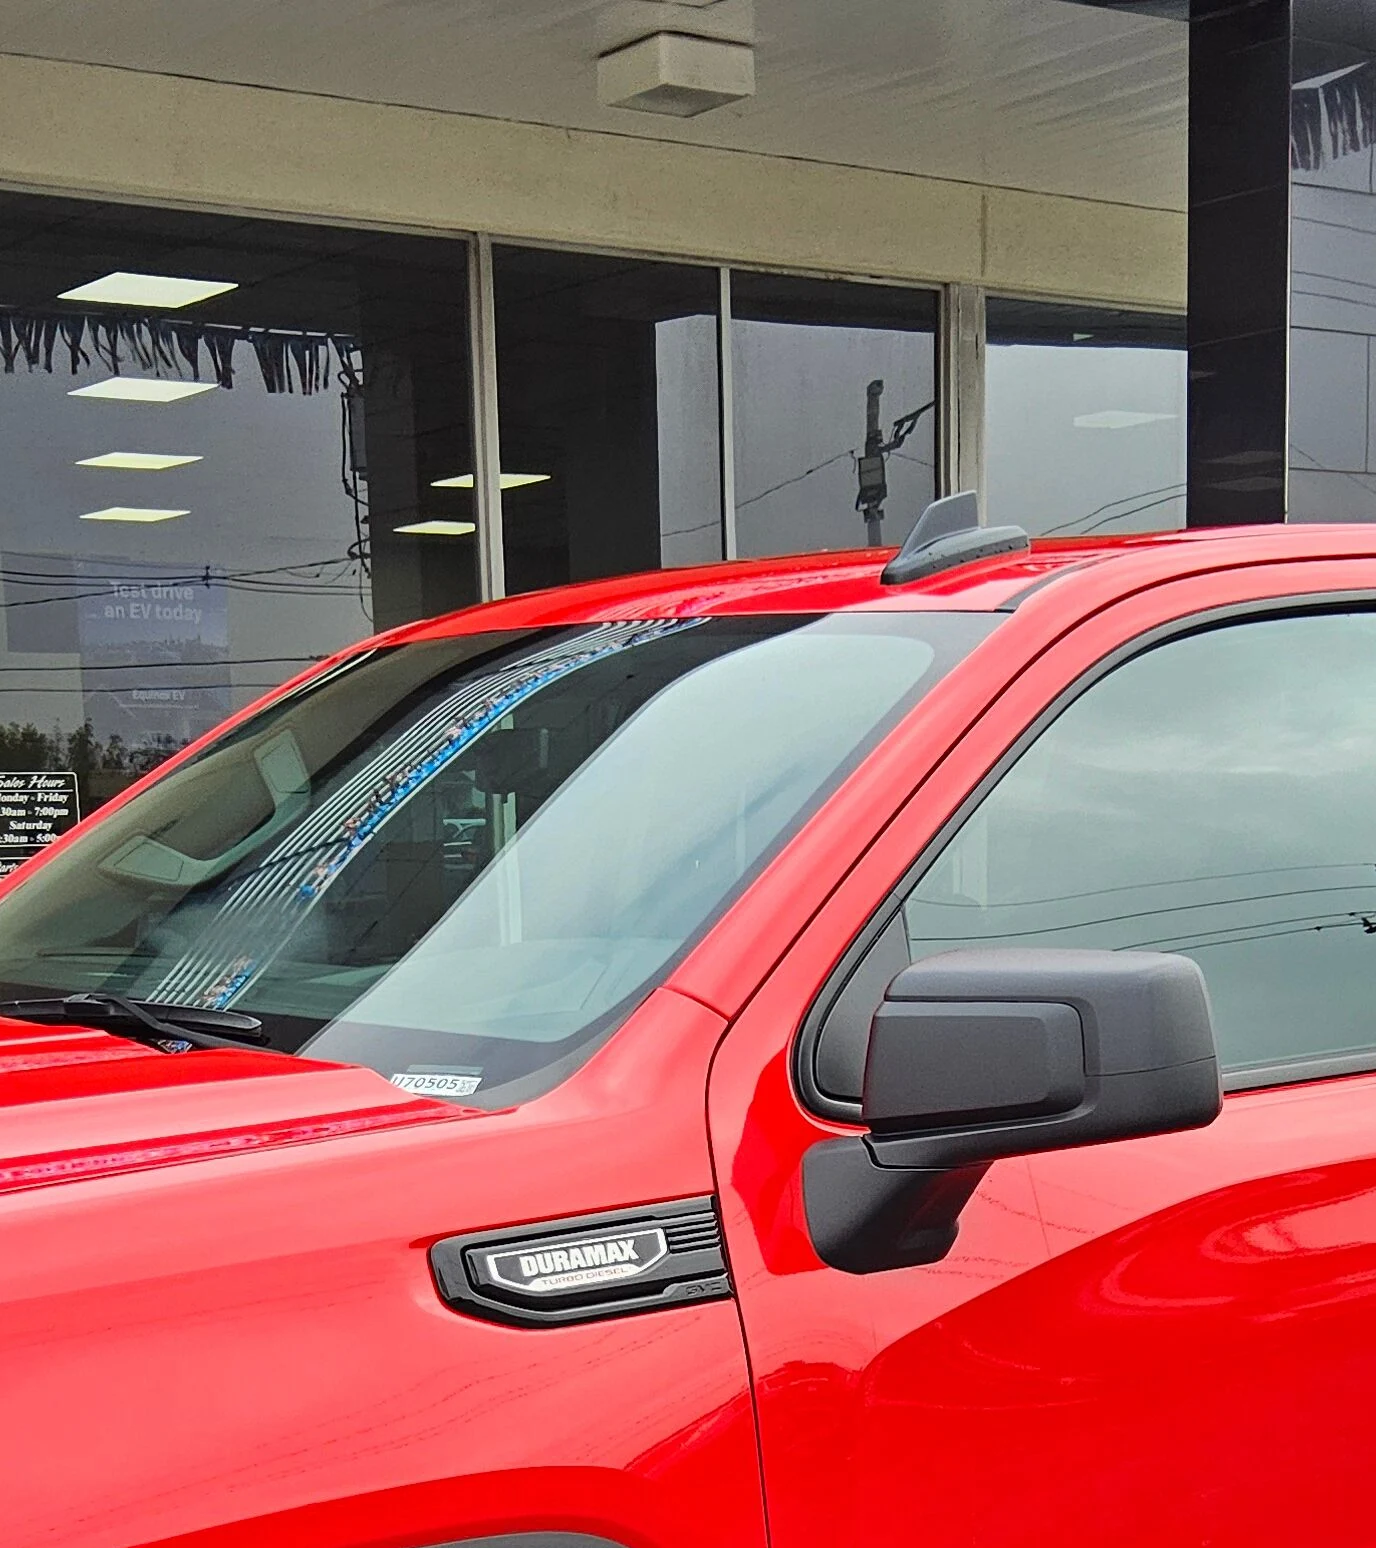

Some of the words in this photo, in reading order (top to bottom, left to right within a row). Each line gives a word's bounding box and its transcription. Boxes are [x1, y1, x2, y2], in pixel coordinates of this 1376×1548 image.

[110, 581, 147, 599] Test
[151, 581, 195, 600] drive
[104, 605, 125, 618] an
[129, 603, 152, 619] EV
[155, 603, 202, 625] today
[27, 775, 66, 789] Hours
[36, 792, 69, 804] Friday
[34, 806, 69, 818] 7:00pm
[9, 820, 53, 831] Saturday
[519, 1239, 640, 1277] DURAMAX
[540, 1273, 584, 1287] TURBO
[585, 1267, 629, 1283] DIESEL
